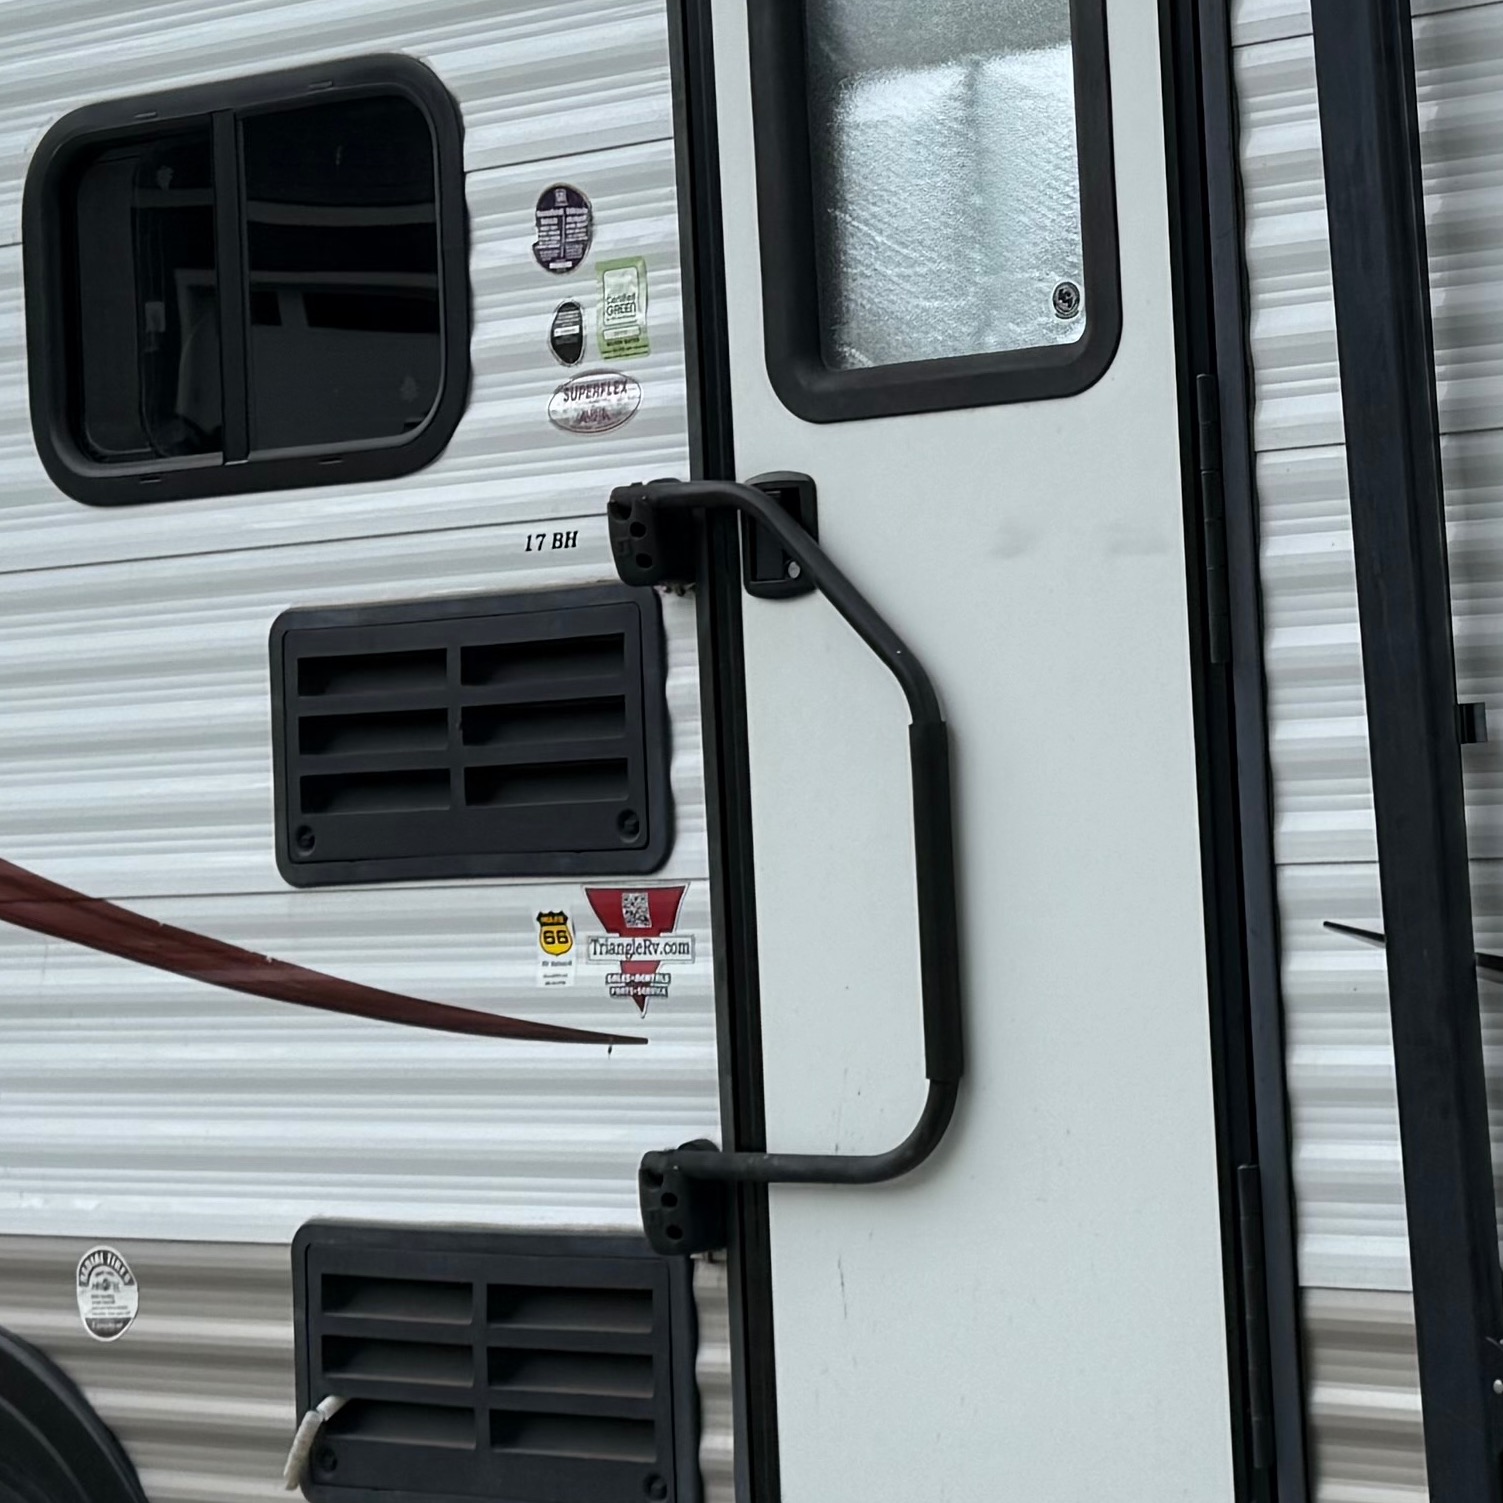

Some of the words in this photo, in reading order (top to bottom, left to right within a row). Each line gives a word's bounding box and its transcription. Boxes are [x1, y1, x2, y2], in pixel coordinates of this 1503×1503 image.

[563, 379, 628, 402] SUPERFLEX
[525, 533, 547, 552] 17
[552, 531, 579, 550] BH
[543, 930, 569, 945] 66
[590, 938, 690, 960] TriangleRv.com
